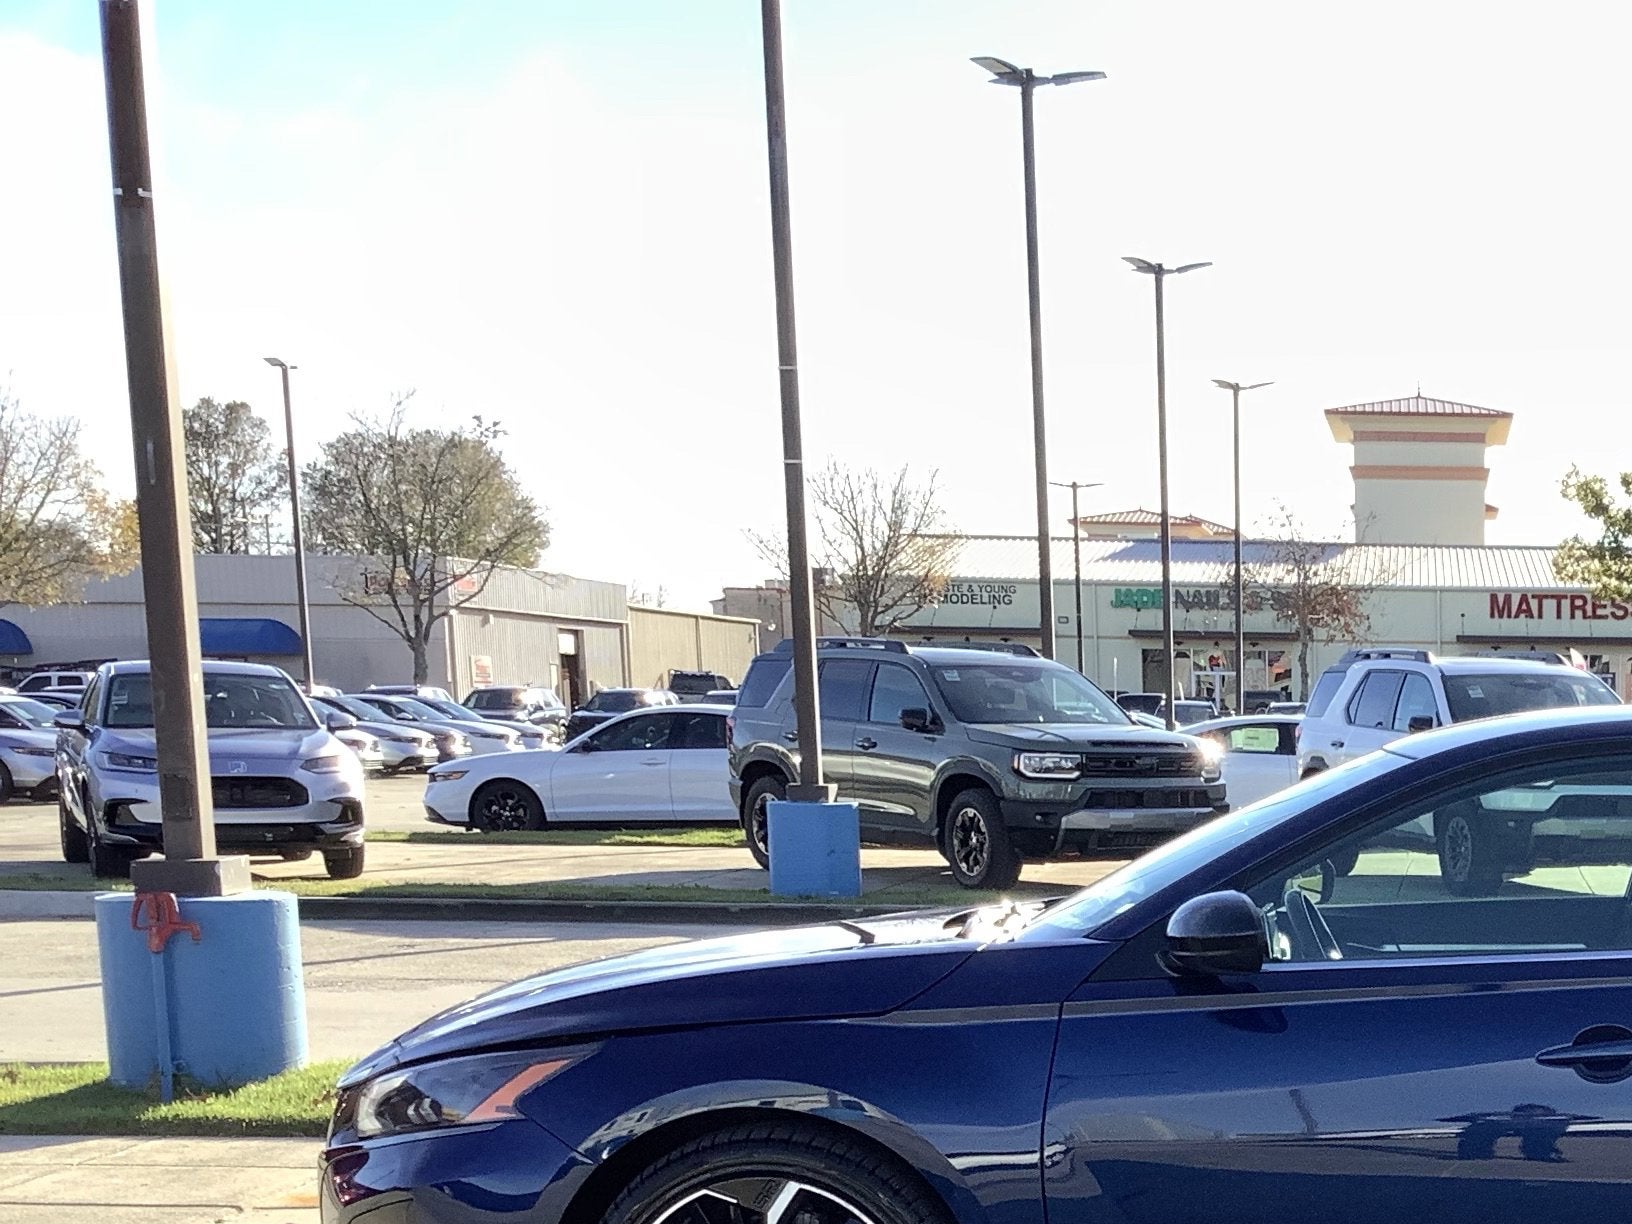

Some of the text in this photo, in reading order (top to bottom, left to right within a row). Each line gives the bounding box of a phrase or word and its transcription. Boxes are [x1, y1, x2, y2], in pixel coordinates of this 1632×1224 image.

[966, 584, 975, 593] &
[977, 584, 1017, 594] YOUNG
[941, 593, 1013, 606] MODELING
